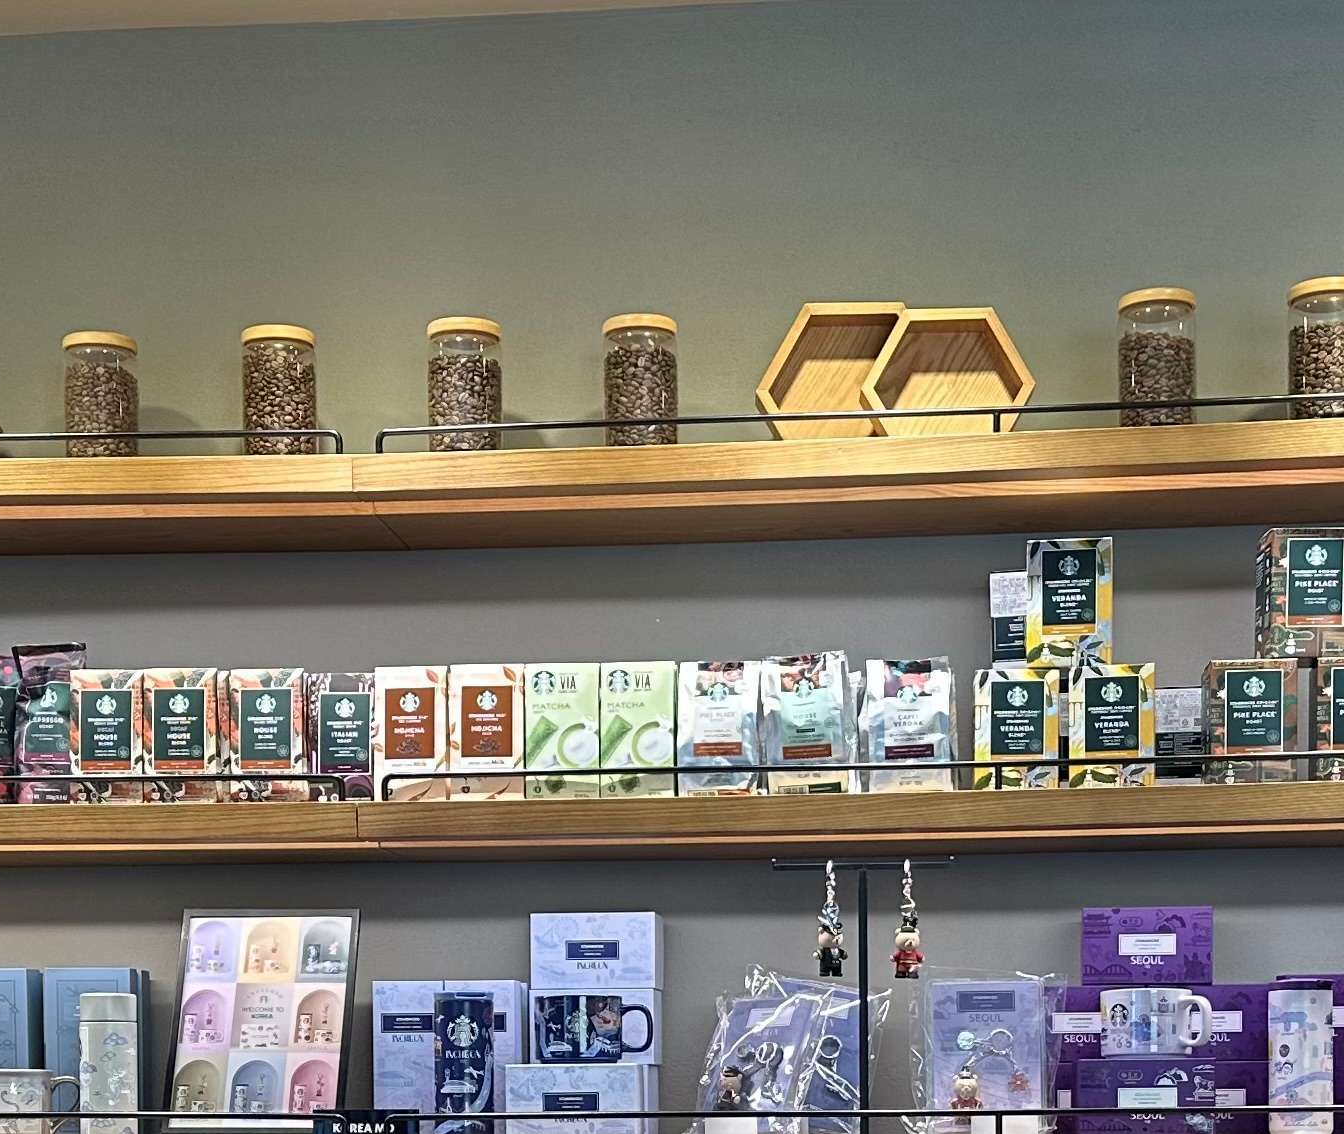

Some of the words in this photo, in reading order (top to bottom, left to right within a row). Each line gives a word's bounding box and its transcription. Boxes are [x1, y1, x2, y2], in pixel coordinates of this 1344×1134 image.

[1051, 594, 1087, 602] VERANDA
[560, 674, 577, 690] VIA
[634, 673, 651, 689] VIA
[532, 702, 571, 711] MATCHA
[606, 700, 646, 710] MATCHA
[999, 725, 1035, 733] VERANDA
[1094, 721, 1130, 729] VERANDA
[1130, 955, 1165, 966] SEOUL
[968, 1013, 1005, 1024] SEOUL
[1063, 1034, 1098, 1044] SEOUL
